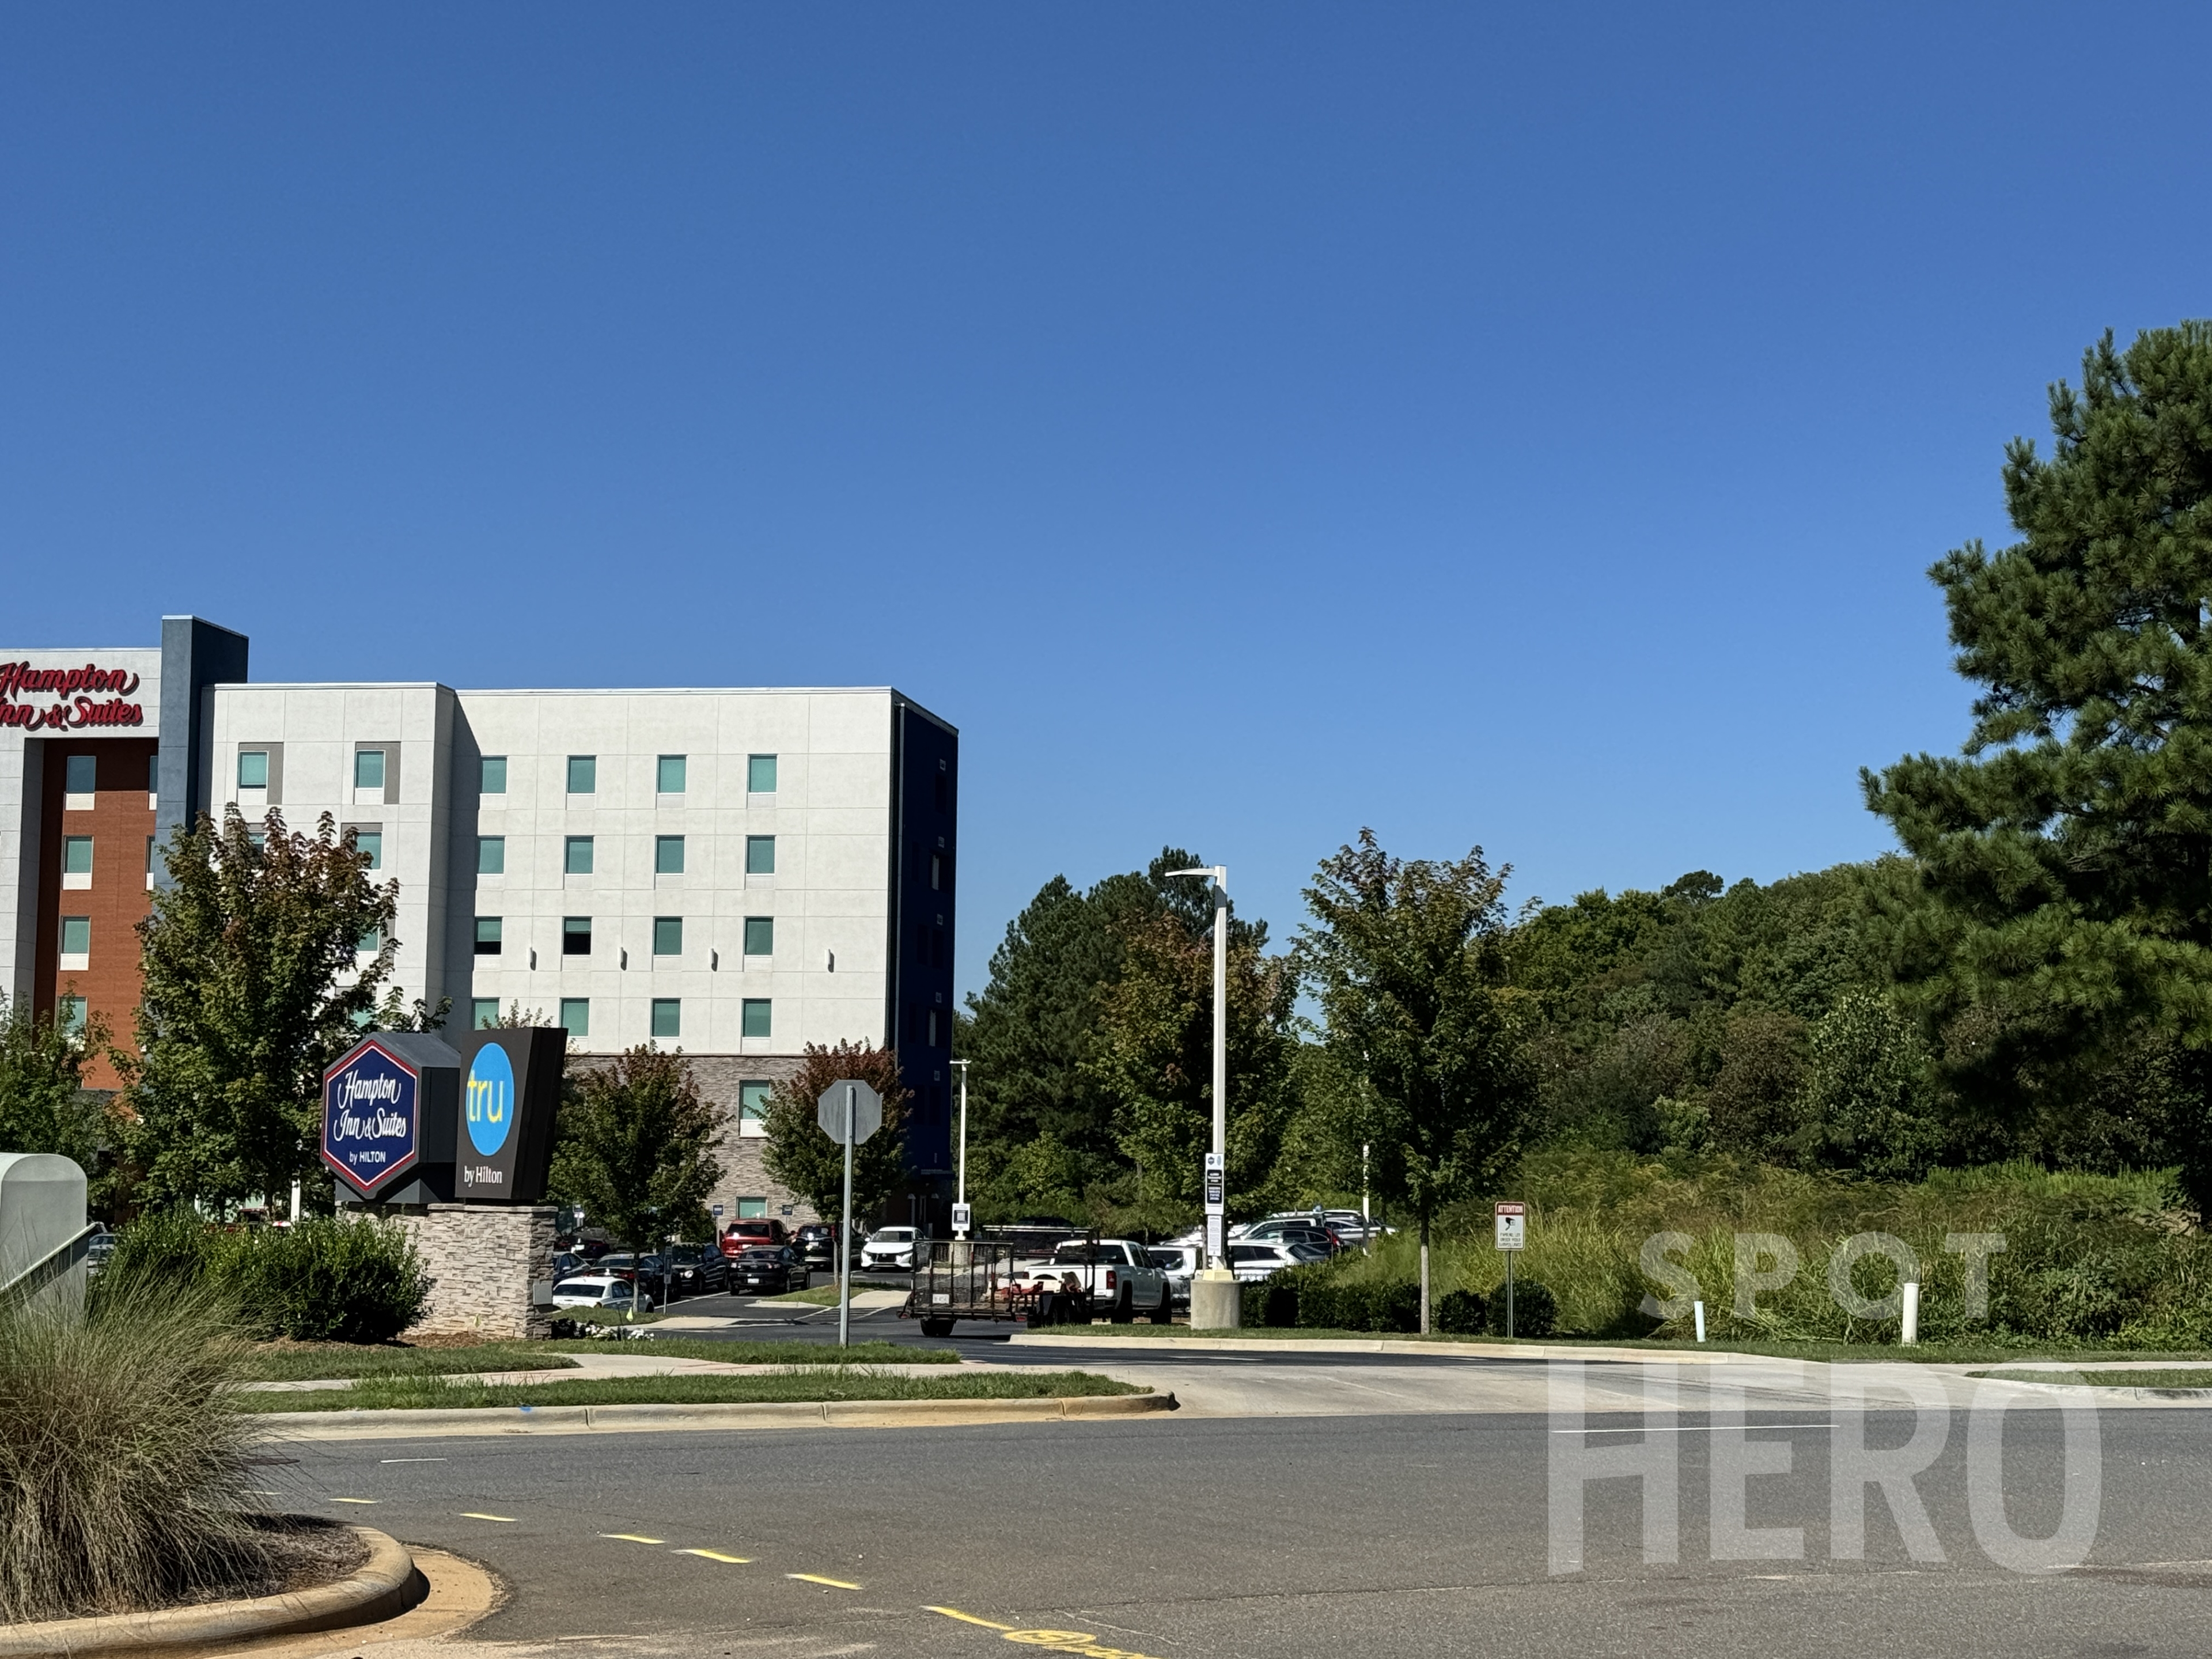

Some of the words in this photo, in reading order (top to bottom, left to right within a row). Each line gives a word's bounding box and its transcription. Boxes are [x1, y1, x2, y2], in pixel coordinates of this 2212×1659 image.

[0, 661, 139, 702] Hampton
[0, 698, 46, 731] nn
[46, 704, 69, 732] &
[63, 696, 143, 728] Suites
[338, 1069, 402, 1109] Hampton
[467, 1069, 504, 1123] tru
[333, 1109, 365, 1142] Inn
[364, 1116, 373, 1141] &
[372, 1107, 407, 1139] Suites
[349, 1151, 358, 1166] by
[359, 1151, 387, 1163] HILTON
[464, 1165, 475, 1188] by
[475, 1165, 503, 1184] Hilton
